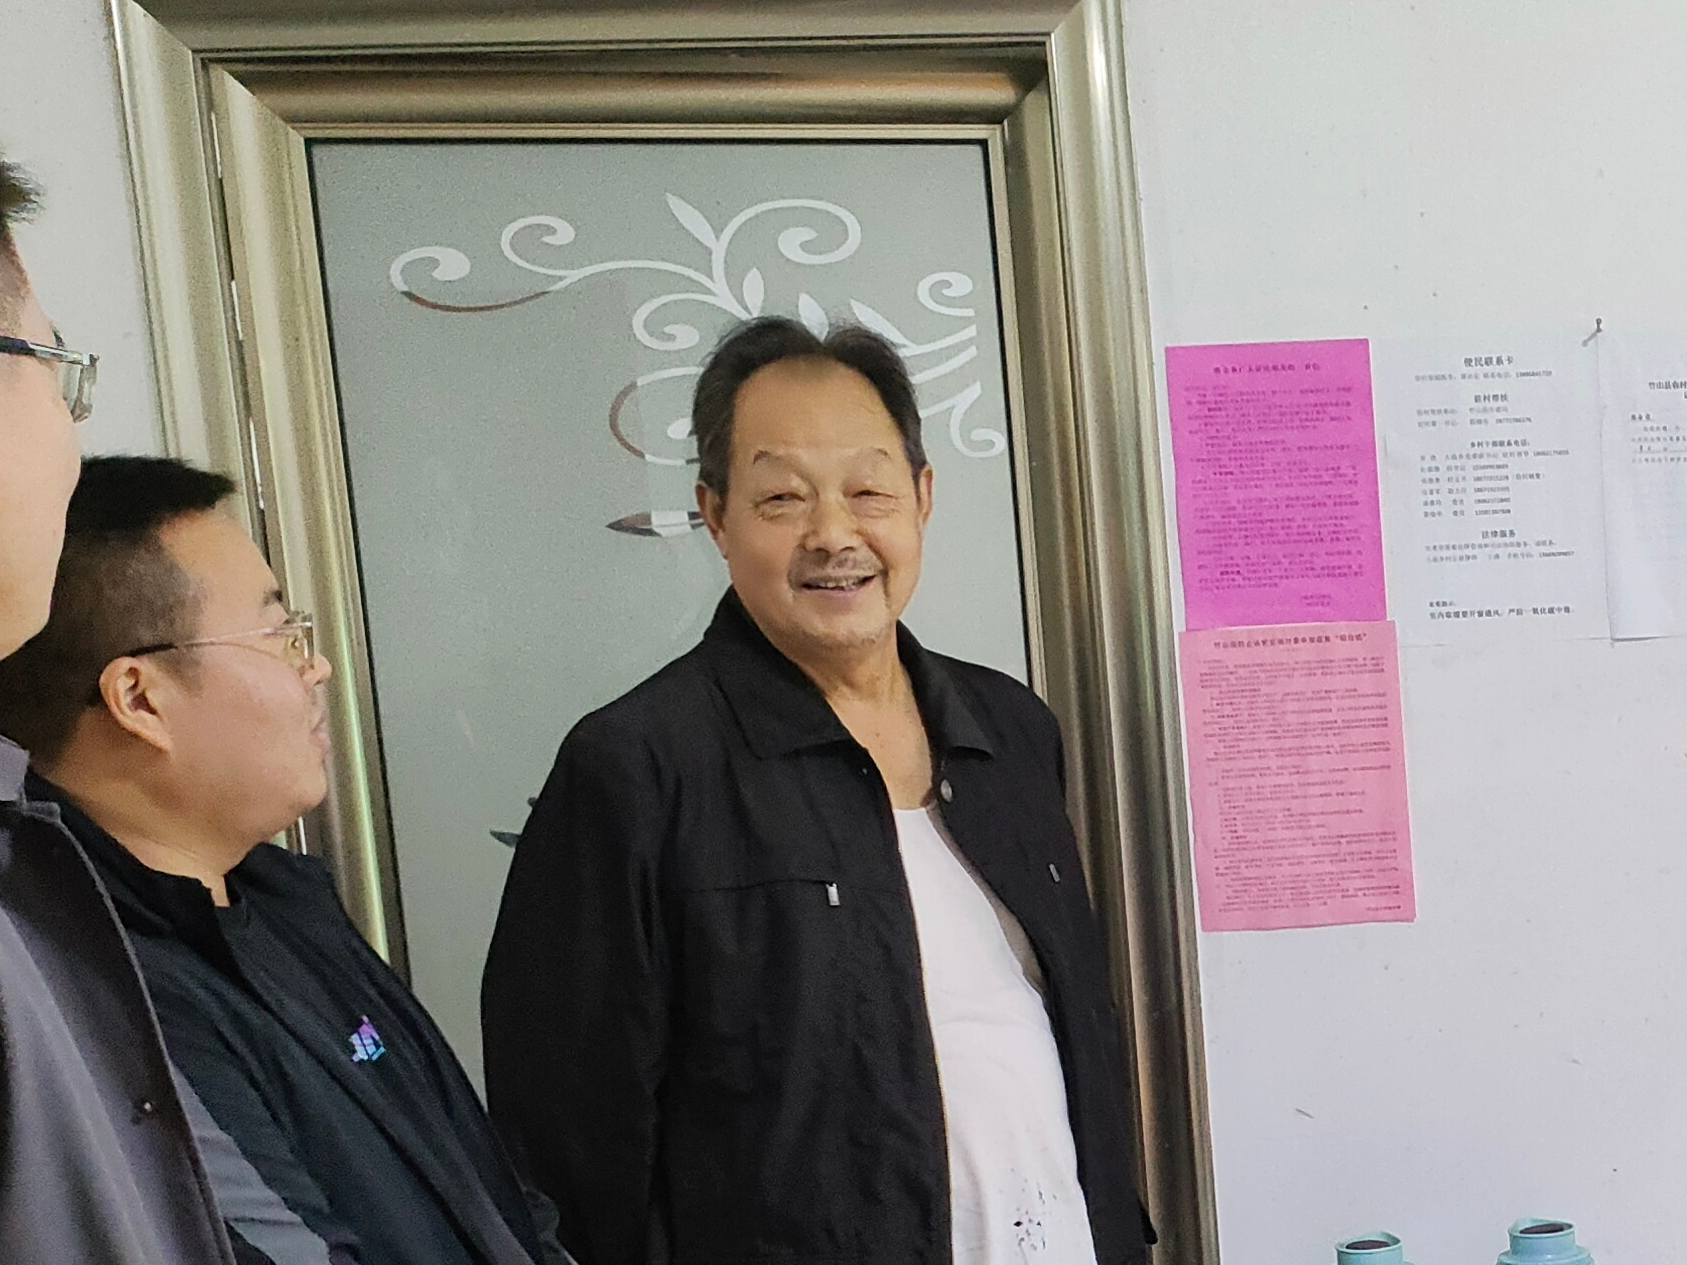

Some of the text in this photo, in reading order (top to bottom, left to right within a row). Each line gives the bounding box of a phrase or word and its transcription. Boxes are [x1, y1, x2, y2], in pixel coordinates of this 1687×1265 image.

[1463, 355, 1515, 368] 便民联系卡
[1481, 529, 1516, 540] 法律服务
